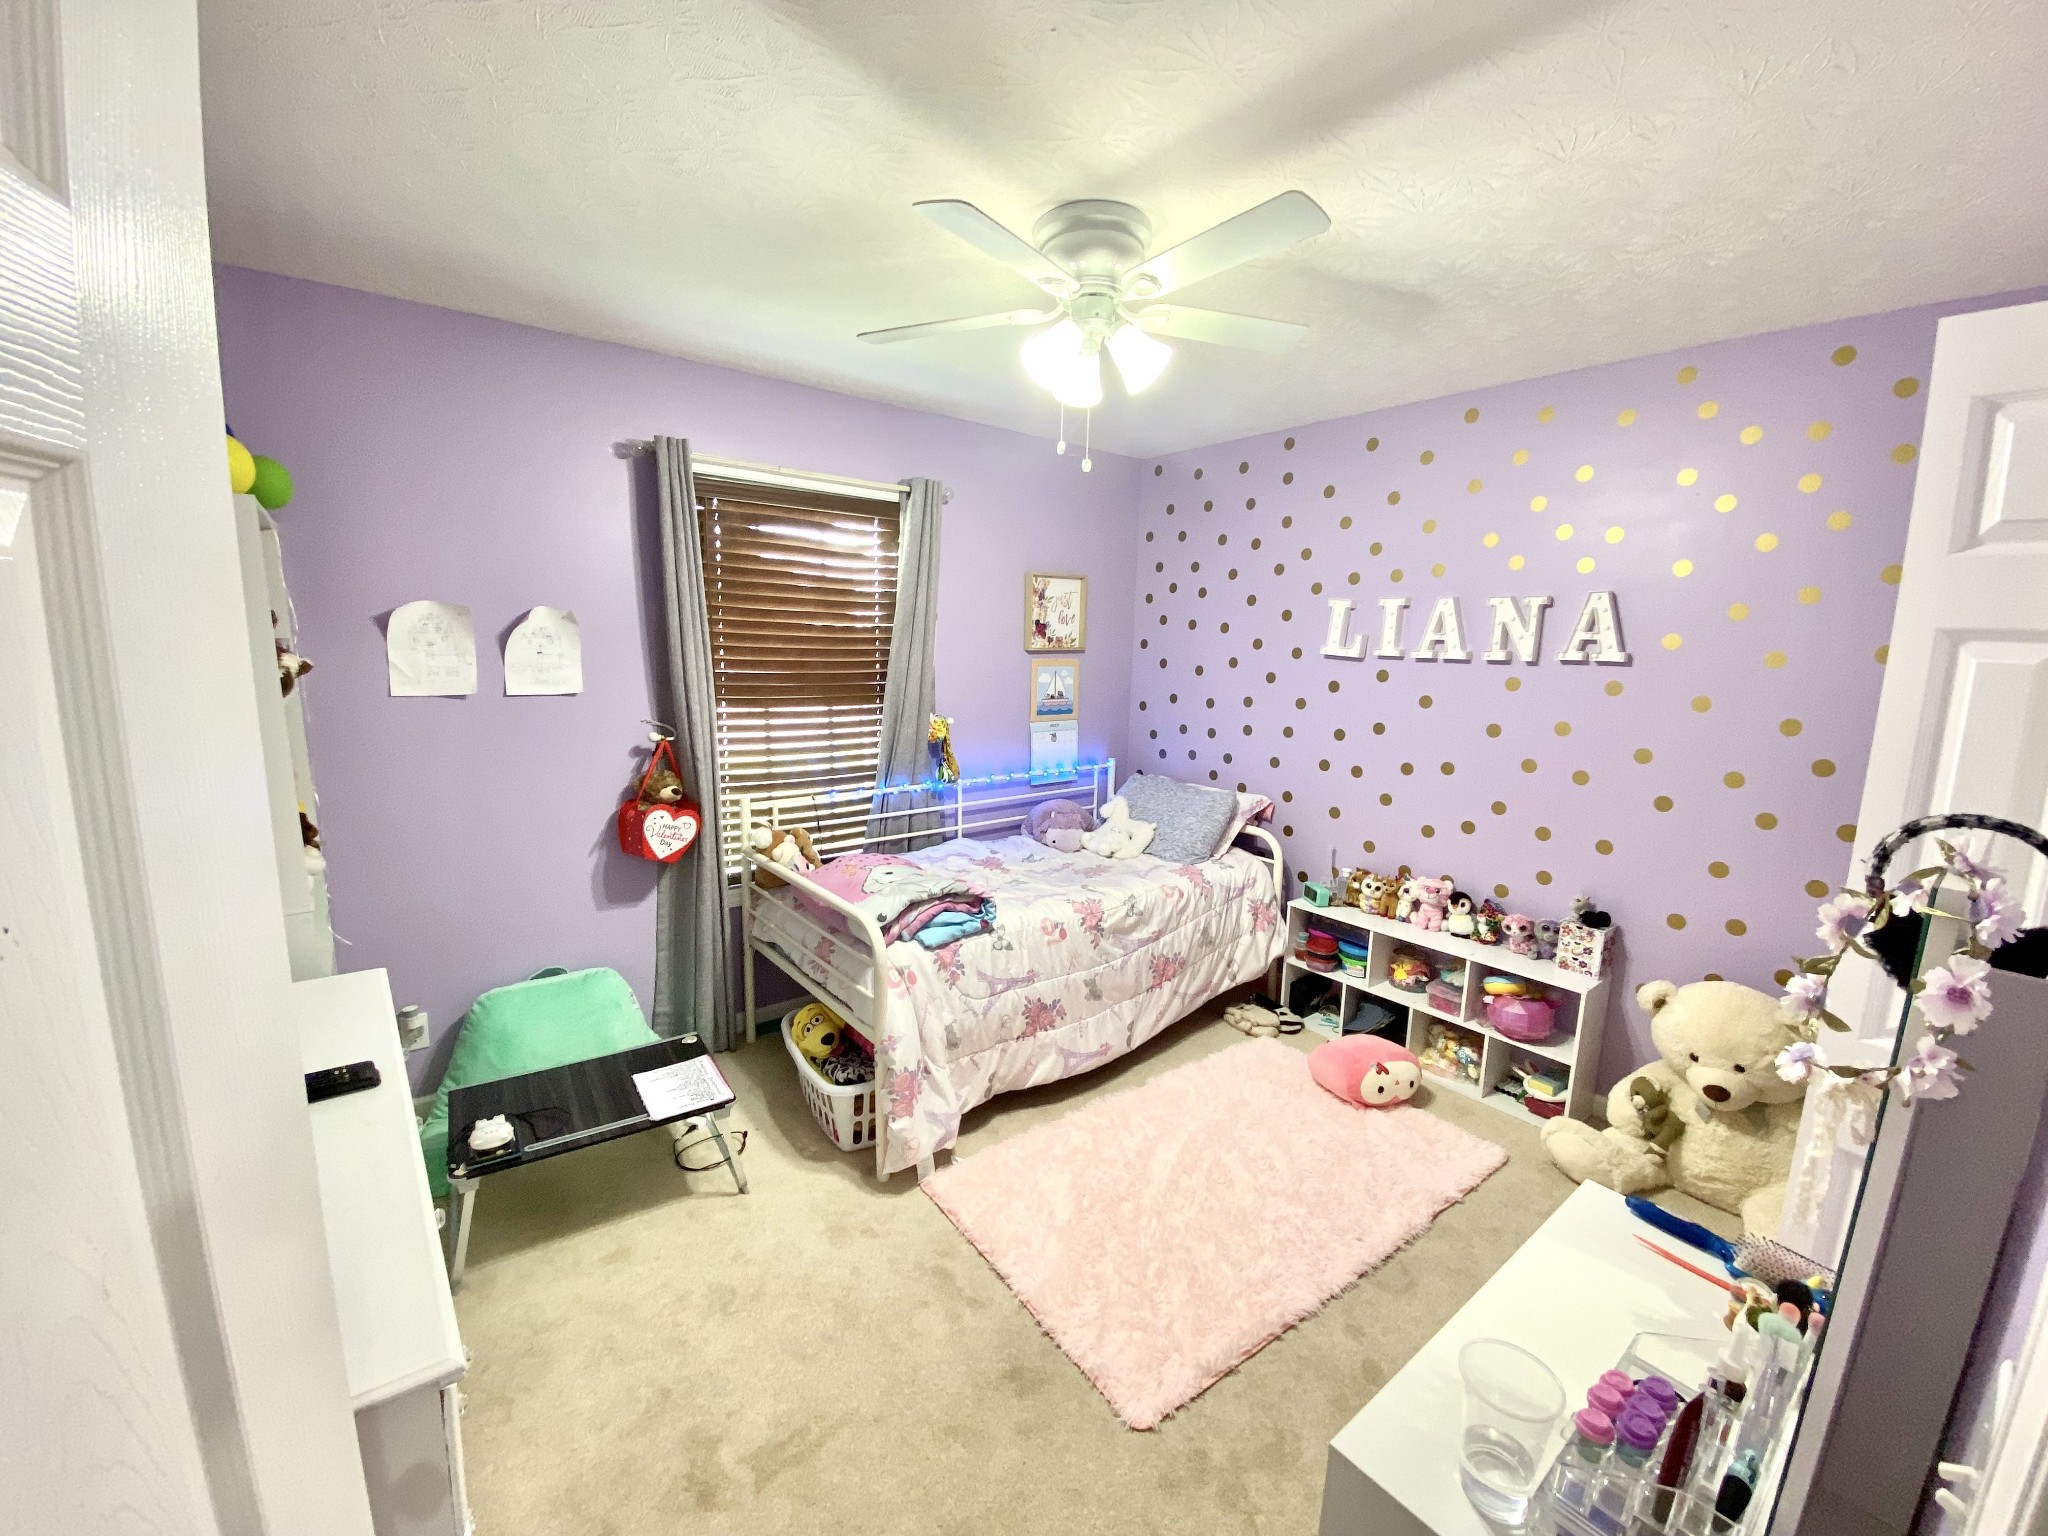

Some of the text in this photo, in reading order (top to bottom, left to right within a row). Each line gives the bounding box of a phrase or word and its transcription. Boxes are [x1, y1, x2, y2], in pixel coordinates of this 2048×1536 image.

[1057, 610, 1076, 627] love
[1319, 591, 1632, 666] LIANA
[662, 823, 682, 832] HAPPY
[659, 838, 673, 848] Day
